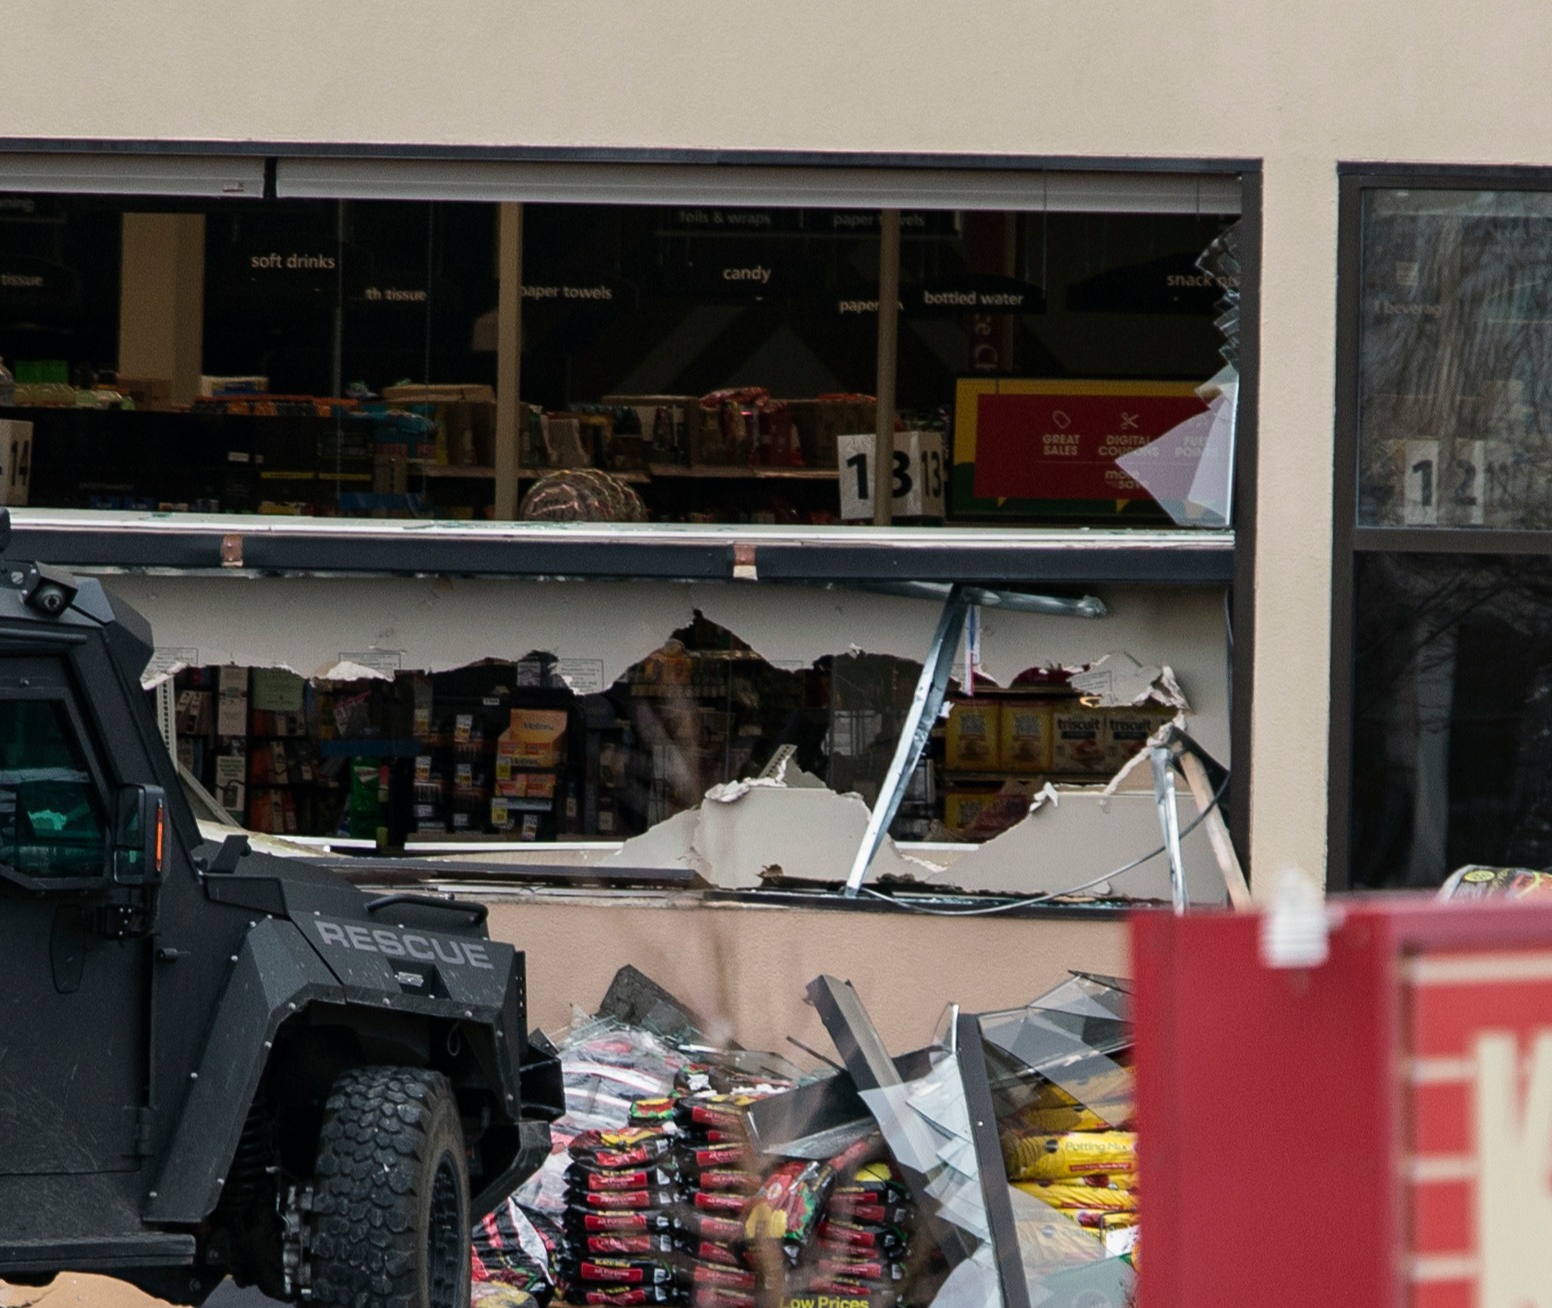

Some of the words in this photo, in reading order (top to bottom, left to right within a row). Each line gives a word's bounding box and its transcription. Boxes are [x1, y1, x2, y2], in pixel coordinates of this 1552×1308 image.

[728, 212, 771, 226] wraps
[833, 213, 874, 228] paper
[251, 253, 283, 269] soft
[286, 253, 336, 270] drinks
[0, 272, 45, 287] tissue
[722, 265, 772, 285] candy
[1166, 274, 1212, 287] snack
[365, 287, 382, 301] th
[384, 288, 427, 302] tissue
[563, 285, 612, 301] towels
[923, 290, 976, 306] bottled
[980, 292, 1024, 306] water
[839, 299, 879, 315] paper
[1042, 433, 1081, 445] GREAT
[1105, 434, 1152, 446] DIGITAL
[1044, 445, 1079, 456] SALES
[846, 449, 914, 501] 13
[920, 449, 942, 498] 13
[1411, 459, 1478, 507] 12
[1057, 717, 1101, 731] triscuit
[1109, 717, 1151, 731] triscuit
[314, 918, 494, 971] RESCUE
[1065, 1141, 1106, 1153] Potting
